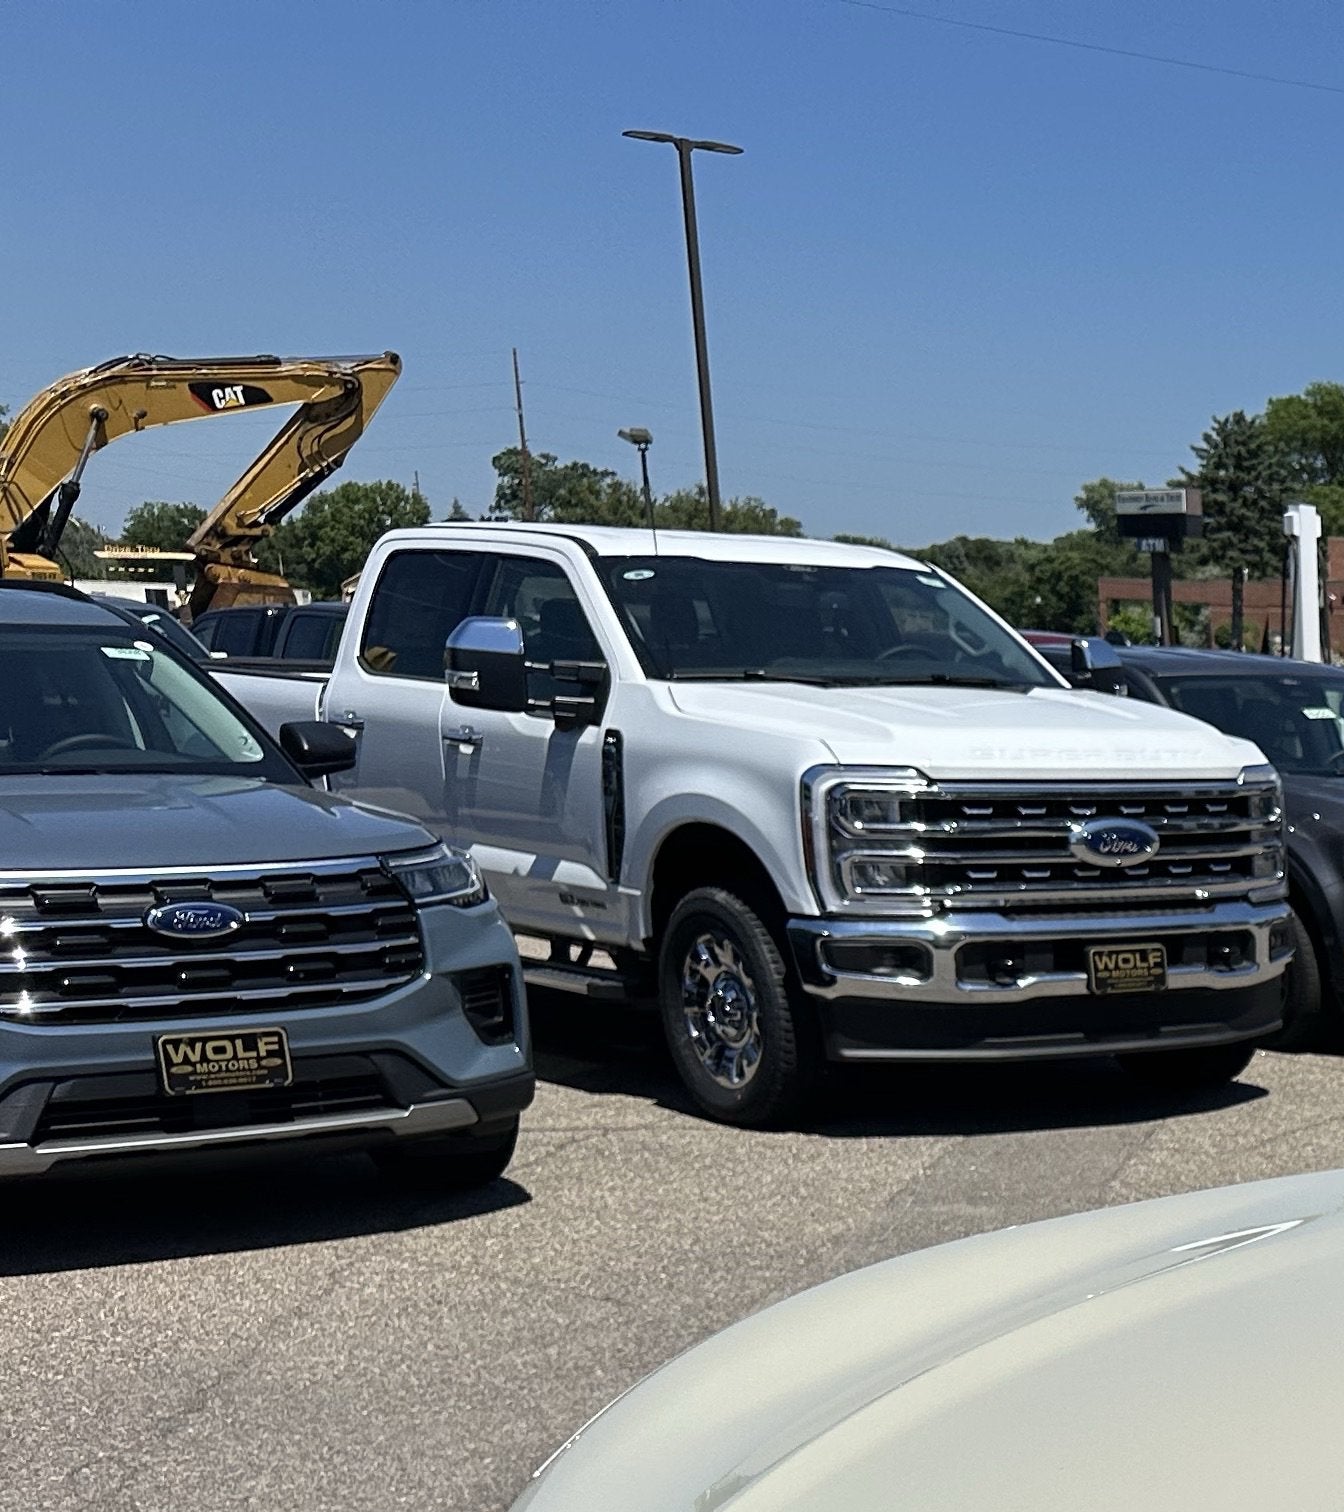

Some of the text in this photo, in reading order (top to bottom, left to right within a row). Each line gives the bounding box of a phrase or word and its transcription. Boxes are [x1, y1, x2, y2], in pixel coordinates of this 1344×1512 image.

[212, 385, 246, 409] CAT
[1141, 539, 1165, 552] ATM
[1094, 951, 1162, 971] WOLF
[166, 1036, 279, 1064] WOLF
[196, 1059, 258, 1073] MOTORS
